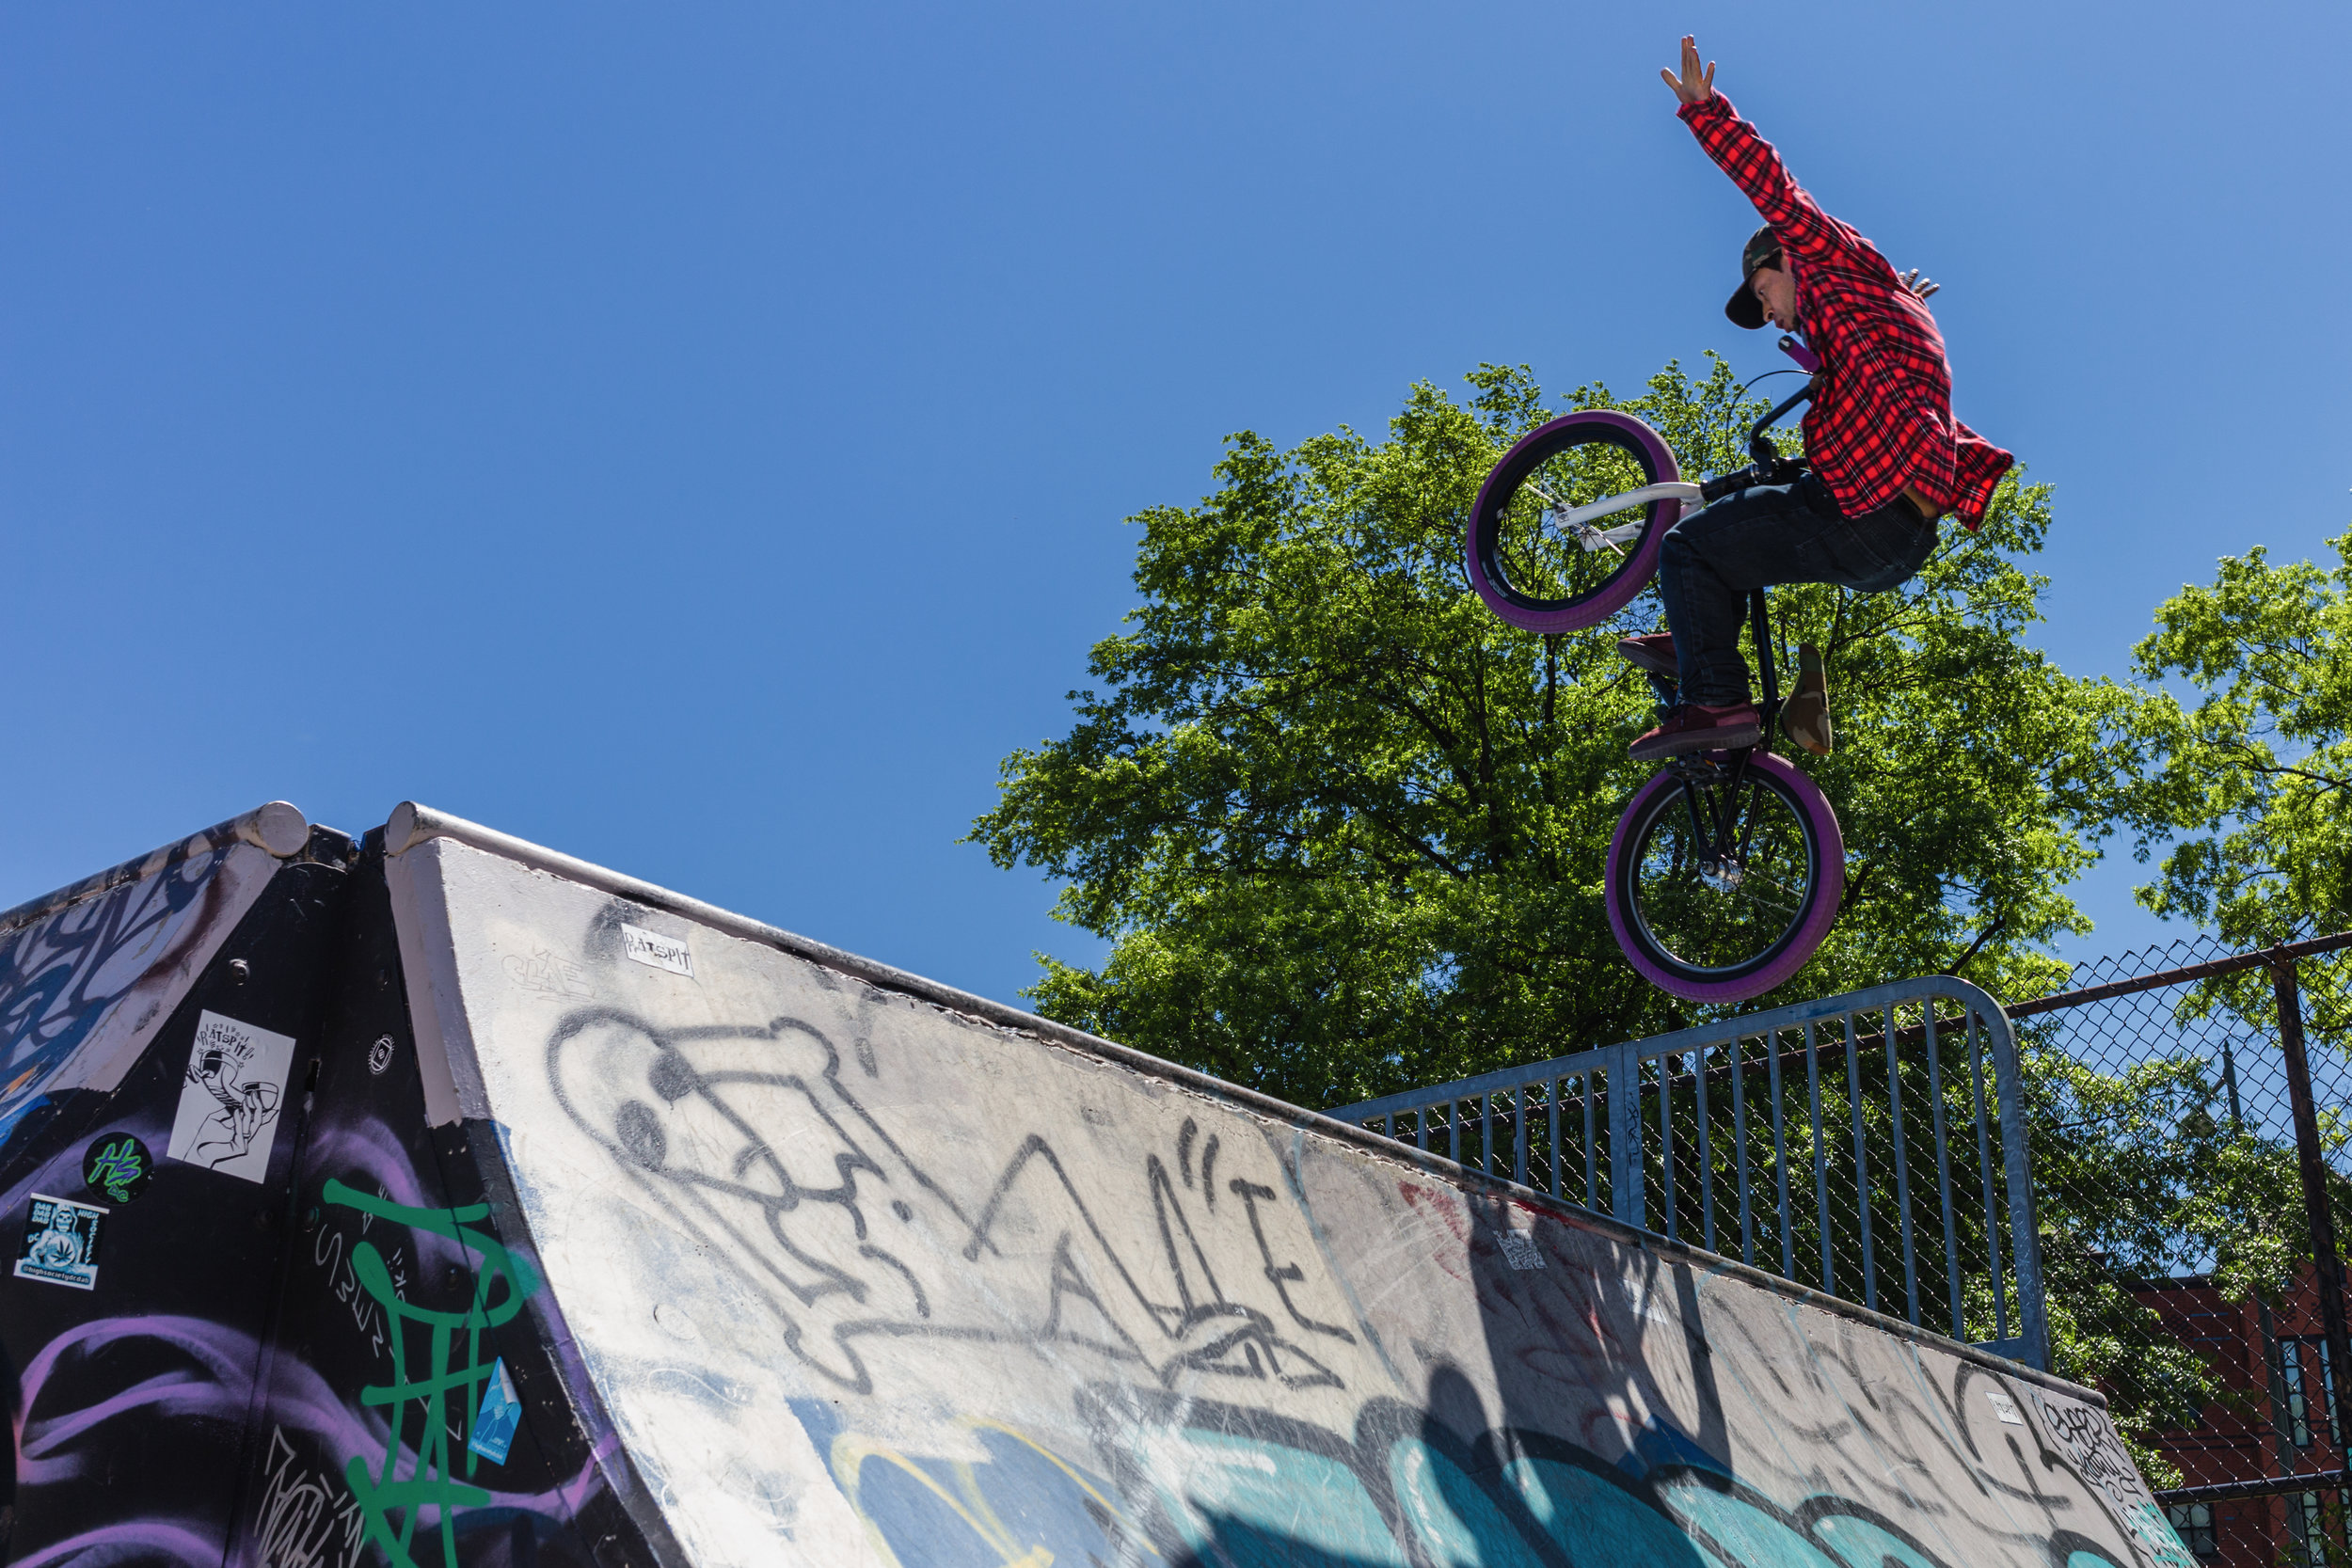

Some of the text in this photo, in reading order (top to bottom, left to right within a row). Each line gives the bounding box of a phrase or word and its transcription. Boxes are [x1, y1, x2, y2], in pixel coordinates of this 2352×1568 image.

[34, 1202, 53, 1212] DAB
[33, 1209, 52, 1218] DAB
[77, 1209, 100, 1220] HIGH
[31, 1215, 50, 1225] DAB
[27, 1232, 40, 1243] DC
[85, 1219, 99, 1264] SOCIETY
